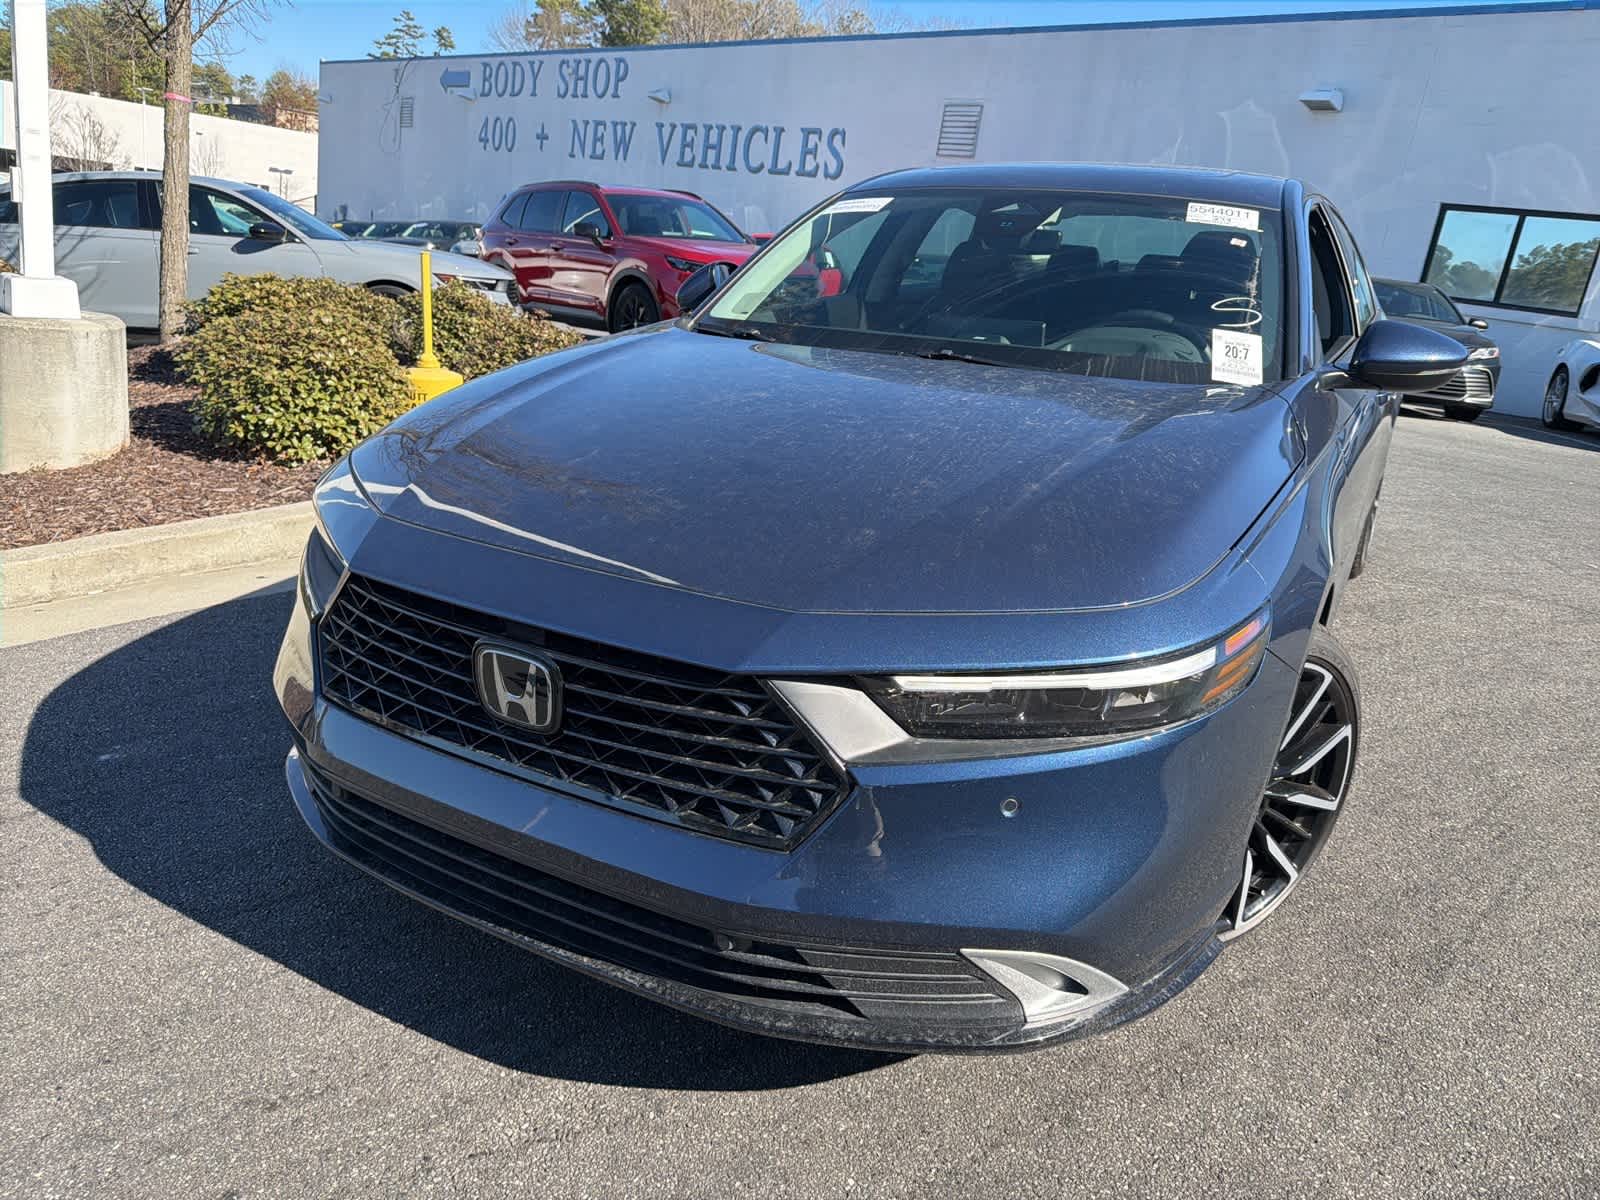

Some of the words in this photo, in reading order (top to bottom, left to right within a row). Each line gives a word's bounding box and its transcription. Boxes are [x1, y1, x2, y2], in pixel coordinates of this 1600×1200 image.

[480, 60, 544, 98] BODY
[556, 57, 629, 99] SHOP
[478, 116, 517, 153] 400
[536, 121, 549, 152] +
[568, 119, 637, 161] NEW
[655, 122, 847, 181] VEHICLES
